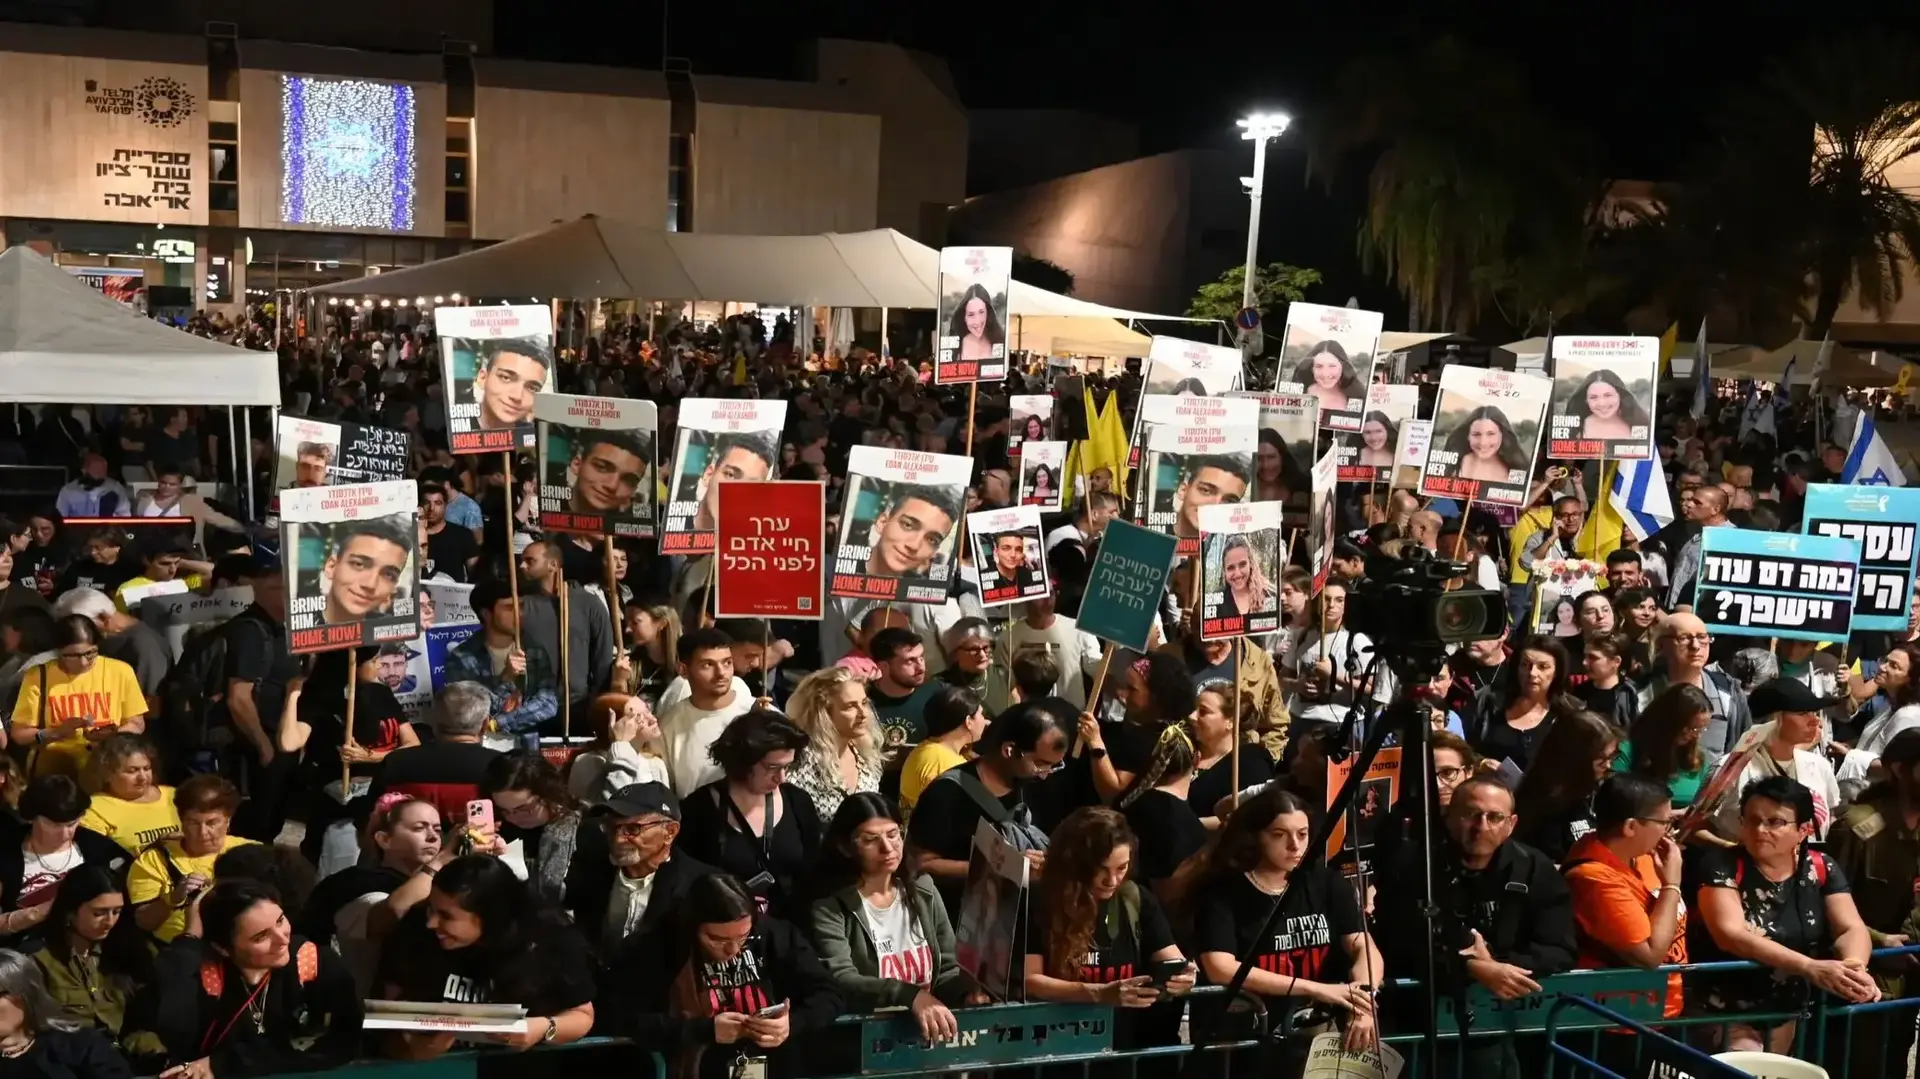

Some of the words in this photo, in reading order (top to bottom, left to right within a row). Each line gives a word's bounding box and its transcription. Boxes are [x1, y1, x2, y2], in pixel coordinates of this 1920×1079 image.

[102, 88, 120, 97] TEL
[85, 96, 108, 105] AVIV
[95, 105, 120, 114] YAFO
[113, 149, 191, 166] ספריית
[152, 181, 191, 195] בית
[104, 193, 190, 210] אריאלה
[1278, 382, 1304, 395] BRING
[450, 403, 481, 418] BRING
[568, 407, 585, 416] EDAN
[586, 409, 621, 419] ALEXANDER
[1193, 407, 1227, 417] ALEXANDER
[451, 418, 471, 433] HIM
[1553, 415, 1581, 428] BRING
[453, 432, 482, 448] HOME
[484, 430, 514, 445] NOW!
[1193, 436, 1226, 445] ALEXANDER
[1552, 427, 1570, 440] HER
[1551, 440, 1577, 453] HOME
[1578, 440, 1606, 453] NOW!
[1429, 450, 1459, 465] BRING
[885, 460, 901, 470] EDAN
[902, 461, 939, 473] ALEXANDER
[1426, 463, 1445, 477] HER
[1425, 477, 1451, 491] HOME
[540, 485, 573, 500] BRING
[321, 500, 339, 510] EDAN
[340, 496, 380, 508] ALEXANDER
[541, 498, 562, 512] HIM
[668, 500, 699, 517] BRING
[344, 509, 358, 518] (20)
[542, 513, 570, 528] HOME
[1148, 512, 1177, 525] BRING
[666, 516, 687, 532] HIM
[749, 517, 790, 536] ערך
[664, 533, 694, 549] HOME
[730, 536, 776, 552] אדם
[782, 537, 810, 552] חיי
[837, 544, 872, 561] BRING
[723, 553, 766, 571] הכל
[773, 554, 816, 572] לפני
[834, 558, 858, 574] HIM
[1102, 551, 1161, 581] מחוייבים
[981, 570, 999, 581] BRING
[1704, 556, 1752, 584] עוד
[1758, 560, 1794, 587] דם
[832, 575, 864, 592] HOME
[866, 576, 898, 594] NOW!
[1100, 568, 1155, 596] לערבות
[1799, 564, 1853, 592] כמה
[290, 596, 326, 614] BRING
[1100, 585, 1145, 611] הדדית
[1204, 592, 1224, 606] BRING
[1204, 606, 1218, 619] HER
[1715, 590, 1834, 626] יישפך?
[291, 614, 314, 630] HIM
[1204, 618, 1222, 632] HOME
[1224, 614, 1244, 630] NOW!
[291, 628, 325, 647] HOME
[328, 622, 362, 642] NOW!
[48, 691, 112, 728] NOW
[1372, 761, 1399, 772] עסקה
